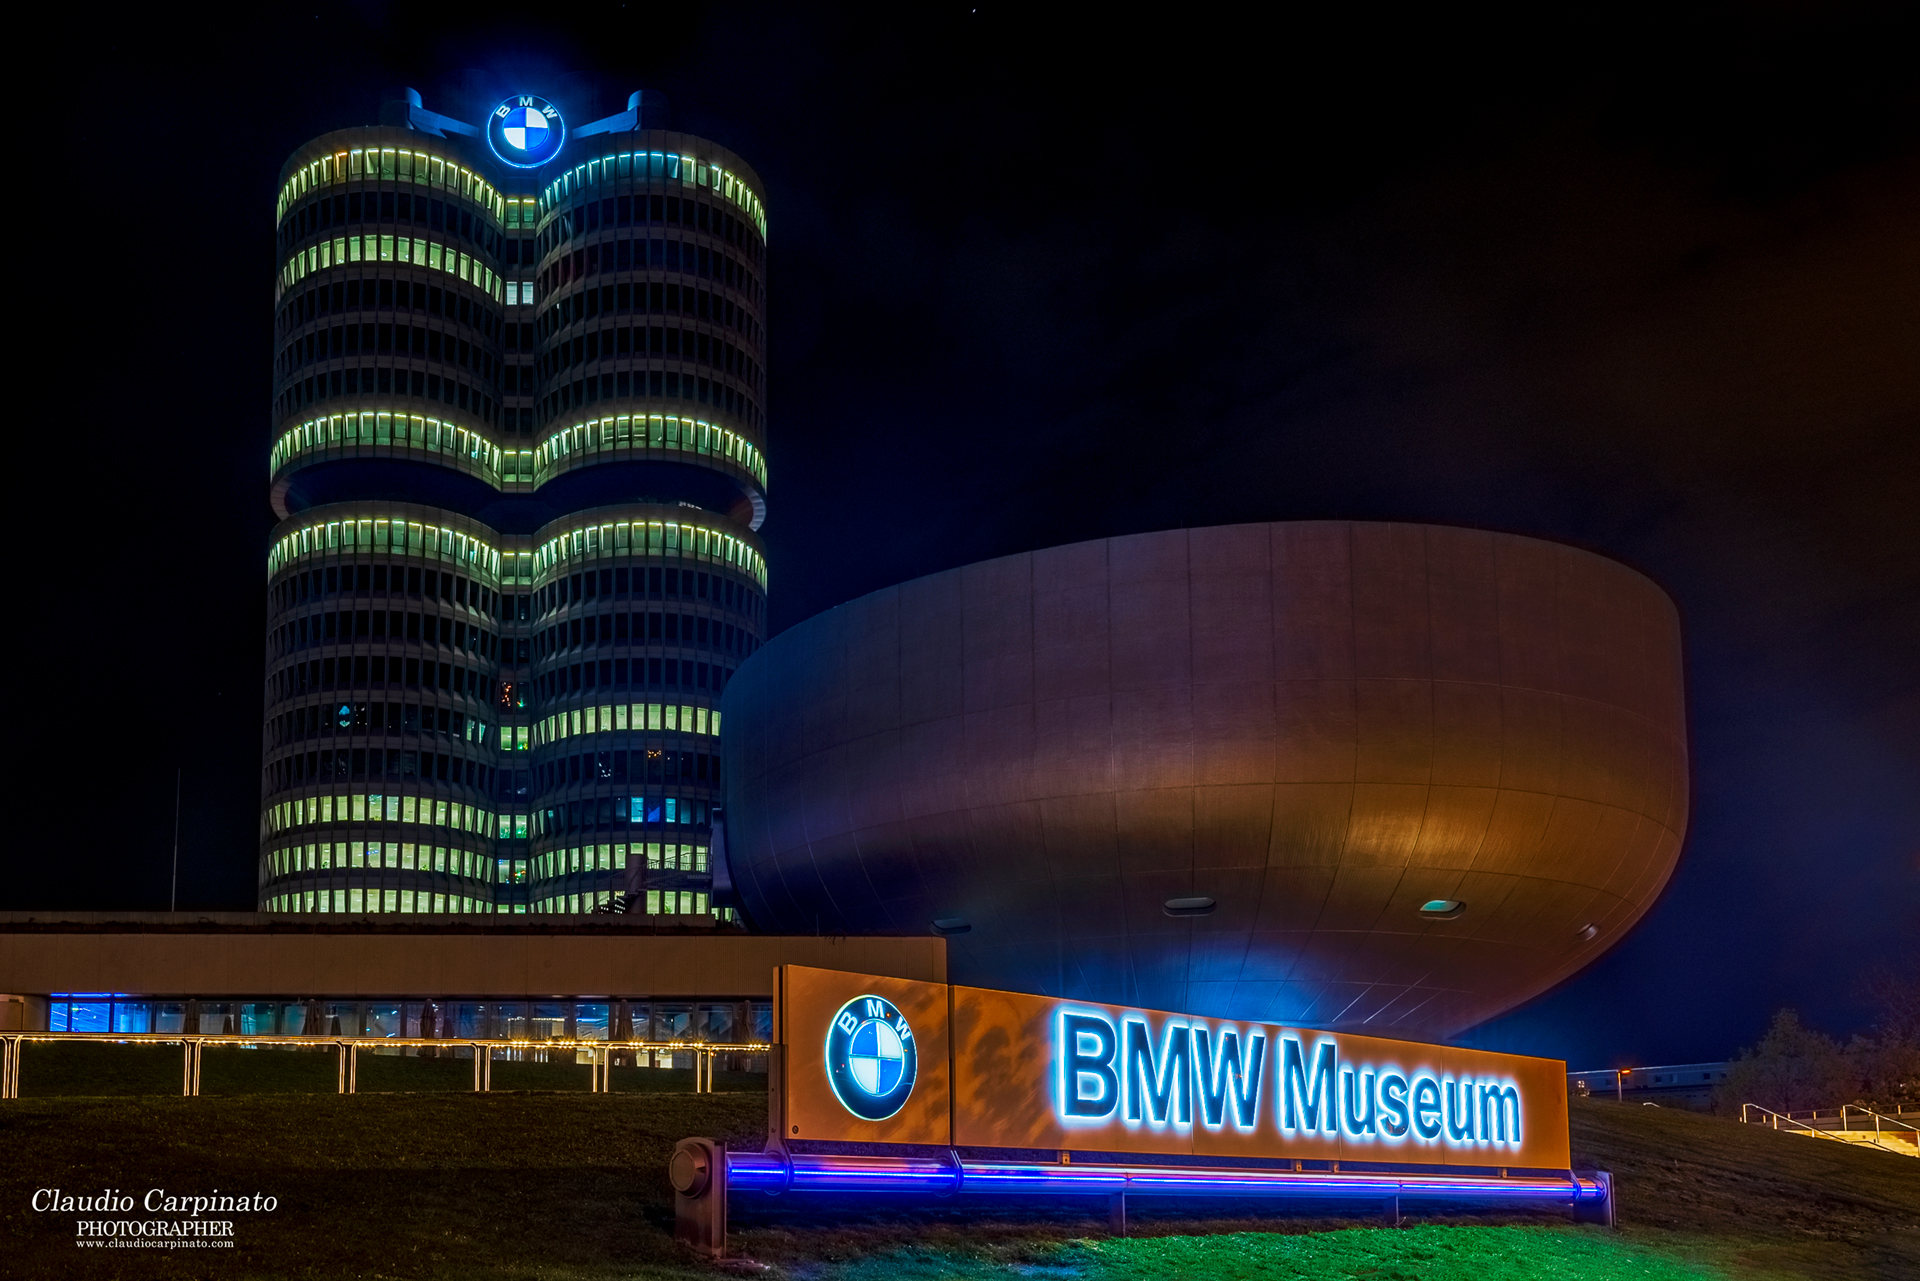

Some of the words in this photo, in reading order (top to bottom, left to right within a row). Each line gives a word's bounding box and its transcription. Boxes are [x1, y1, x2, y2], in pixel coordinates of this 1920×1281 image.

[495, 96, 558, 119] BMW
[837, 999, 911, 1041] BMW
[1061, 1012, 1266, 1127] BMW
[1281, 1038, 1522, 1143] Museum
